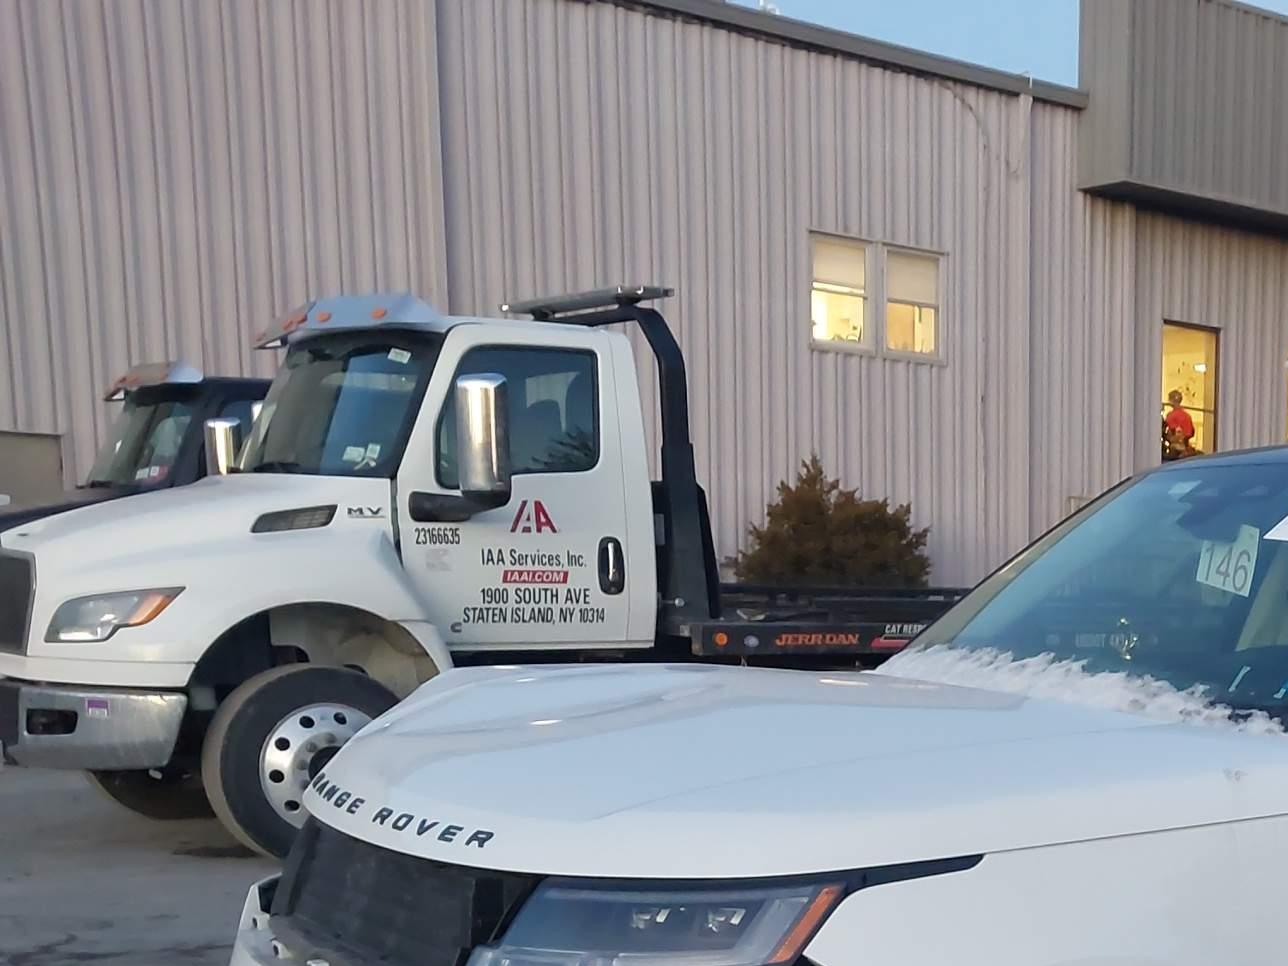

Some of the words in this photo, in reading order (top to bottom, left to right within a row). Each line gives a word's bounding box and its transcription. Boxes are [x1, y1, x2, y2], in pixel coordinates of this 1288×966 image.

[347, 507, 382, 516] MV
[415, 528, 461, 545] 23166635
[481, 549, 506, 566] IAA
[510, 550, 564, 569] Services,
[567, 550, 587, 568] Inc.
[1204, 542, 1251, 594] 146
[506, 572, 564, 582] IAAI.COM
[481, 589, 509, 605] 1900
[514, 588, 559, 605] SOUTH
[564, 588, 590, 605] AVE
[463, 607, 507, 624] STATEN
[510, 607, 555, 625] ISLAND,
[559, 607, 575, 623] NY
[579, 607, 605, 623] 10314
[885, 624, 901, 634] CAT
[311, 772, 366, 814] RANGE
[371, 807, 495, 848] ROVER
